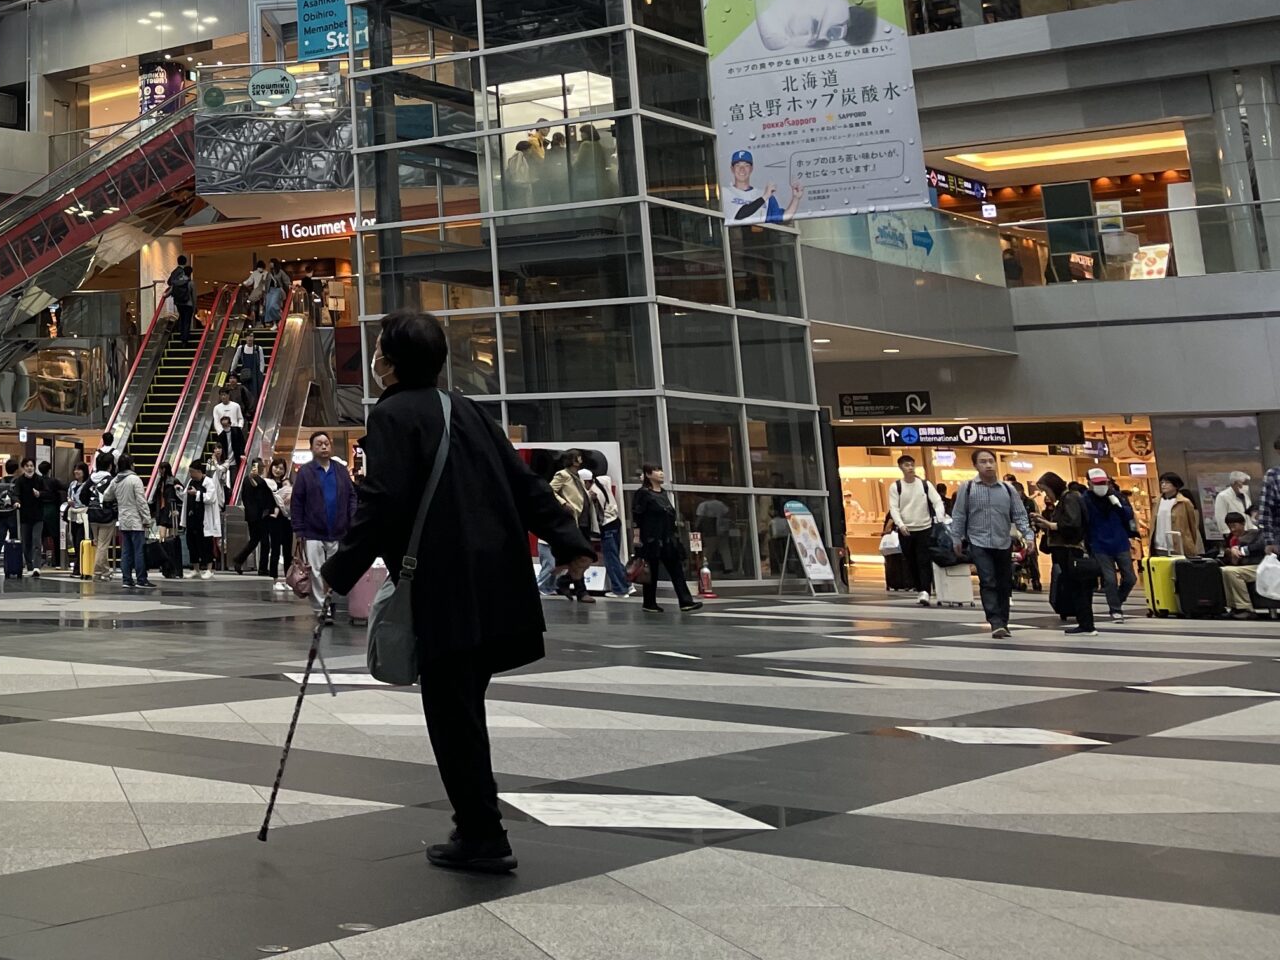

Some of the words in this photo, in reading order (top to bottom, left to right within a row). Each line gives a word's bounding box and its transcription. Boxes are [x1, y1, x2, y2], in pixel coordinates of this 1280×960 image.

[303, 8, 337, 22] Obihiro,
[782, 69, 840, 93] 北海道
[728, 81, 902, 123] 富良野ホップ炭酸水
[291, 220, 347, 238] Gourmet
[919, 434, 960, 442] International
[979, 435, 1007, 443] Parking
